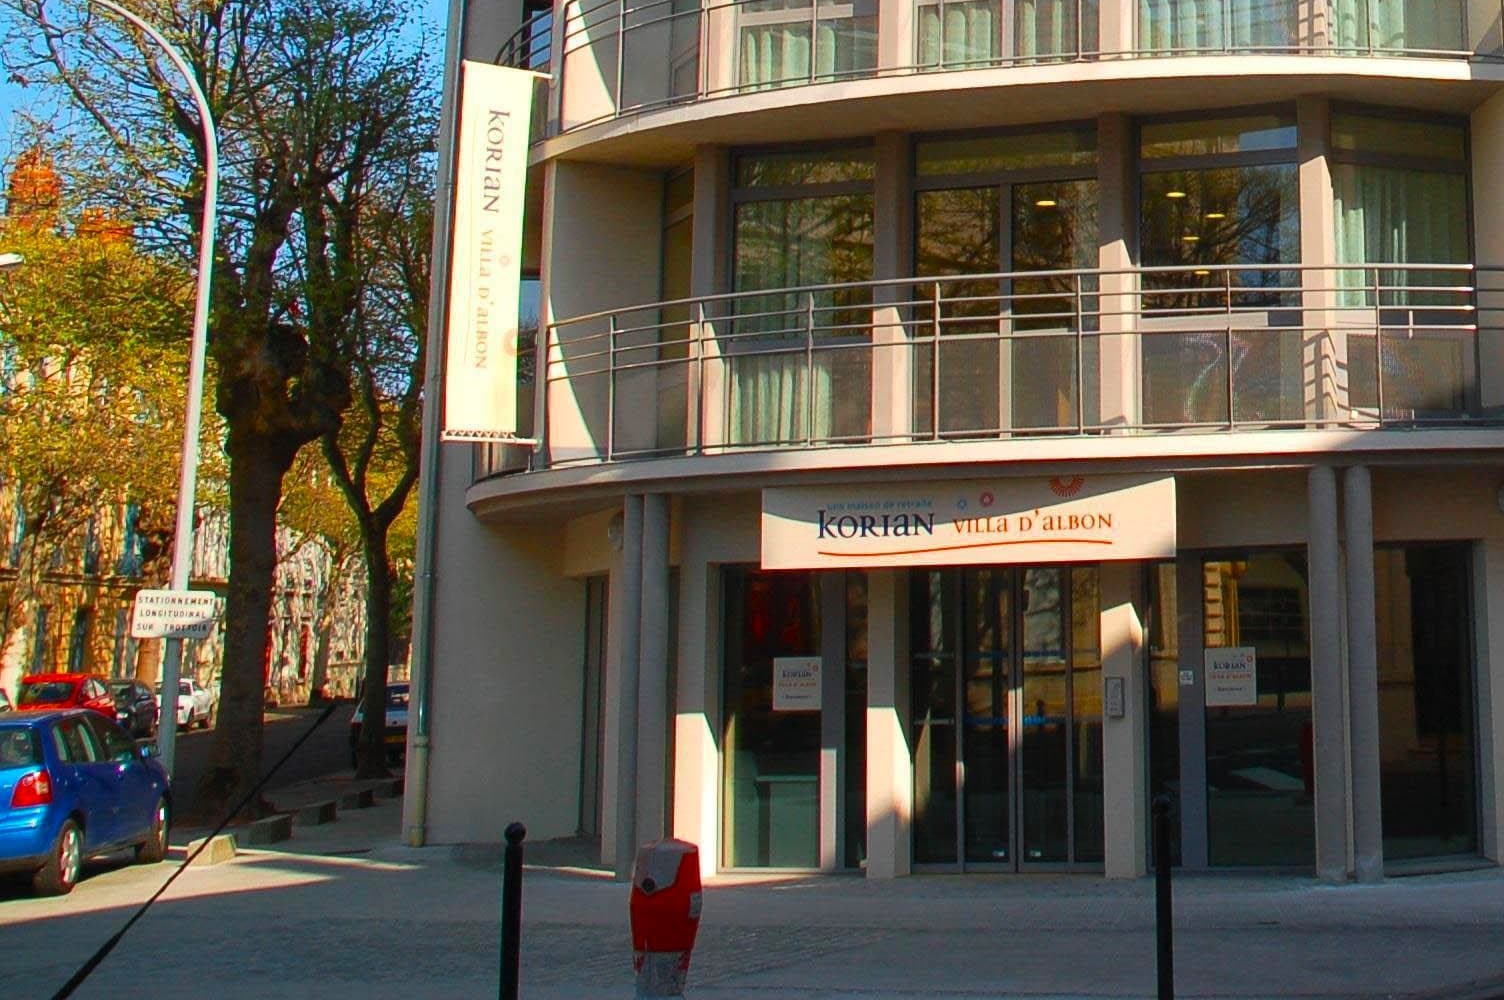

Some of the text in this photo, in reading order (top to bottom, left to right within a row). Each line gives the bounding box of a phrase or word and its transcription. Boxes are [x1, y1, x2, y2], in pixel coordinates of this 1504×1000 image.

[138, 596, 213, 606] STATIONNEMENT
[140, 609, 206, 619] LONGITUDINAL
[136, 623, 208, 632] SUR TROTTOIR
